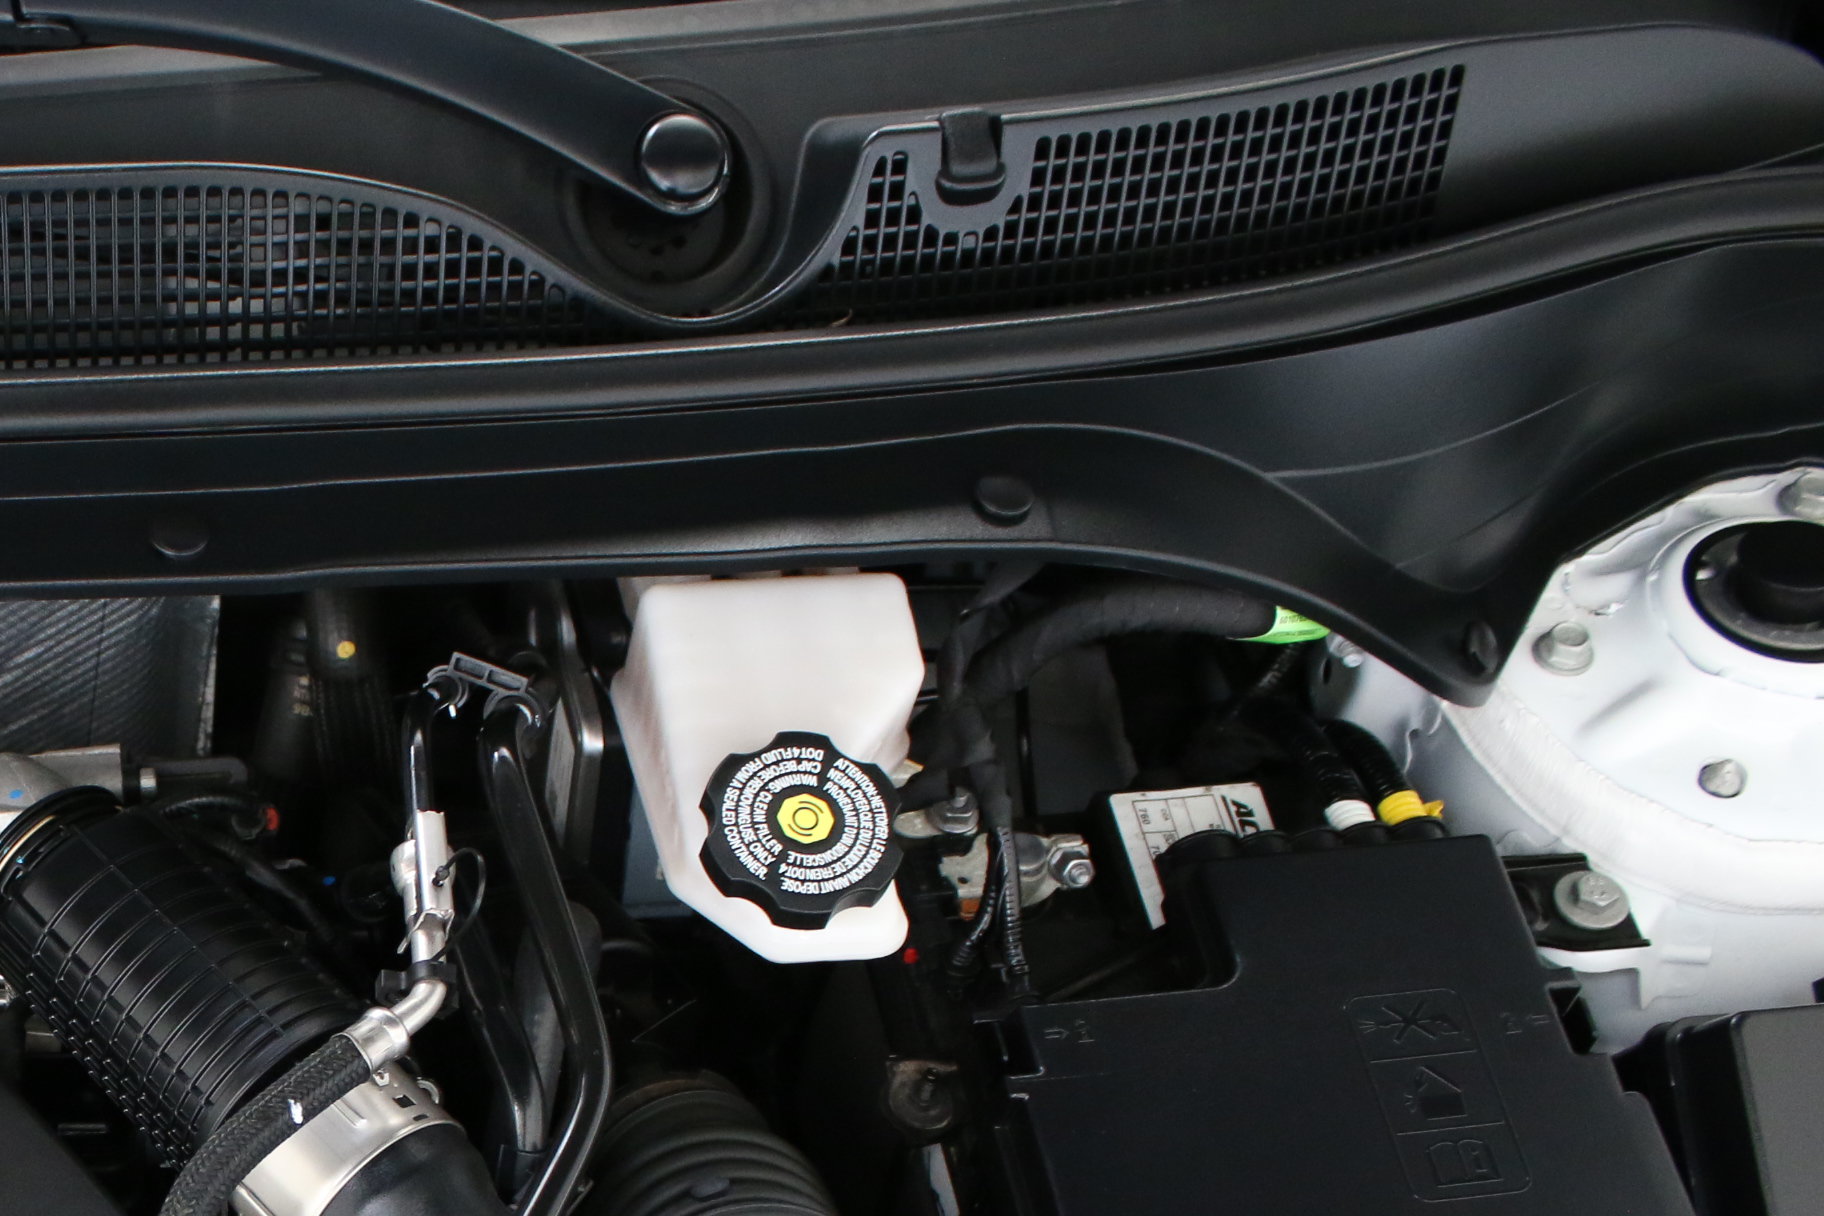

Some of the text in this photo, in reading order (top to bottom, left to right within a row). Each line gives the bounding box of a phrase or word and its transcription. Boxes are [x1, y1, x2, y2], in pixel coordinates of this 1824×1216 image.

[760, 747, 793, 764] FLUID
[798, 747, 824, 761] DOT
[734, 758, 764, 783] FROM
[756, 760, 798, 783] BEFORE
[797, 760, 821, 773] CAP
[722, 787, 740, 825] SEALED
[753, 791, 773, 822] CLEAN
[823, 781, 858, 828] PROVENANT
[858, 811, 874, 830] QUE
[868, 795, 888, 839] NETTOYER
[1138, 807, 1152, 826] 760
[738, 823, 757, 844] USE
[754, 823, 783, 855] FILLER
[724, 826, 768, 880] CONTAINER.
[749, 842, 776, 865] ONLY
[821, 841, 849, 863] BIDON
[840, 839, 870, 870] LIQUIDE
[784, 865, 805, 879] DOT
[805, 866, 835, 880] FREIN
[846, 848, 882, 883] BOUCHON
[820, 875, 850, 893] AVANT
